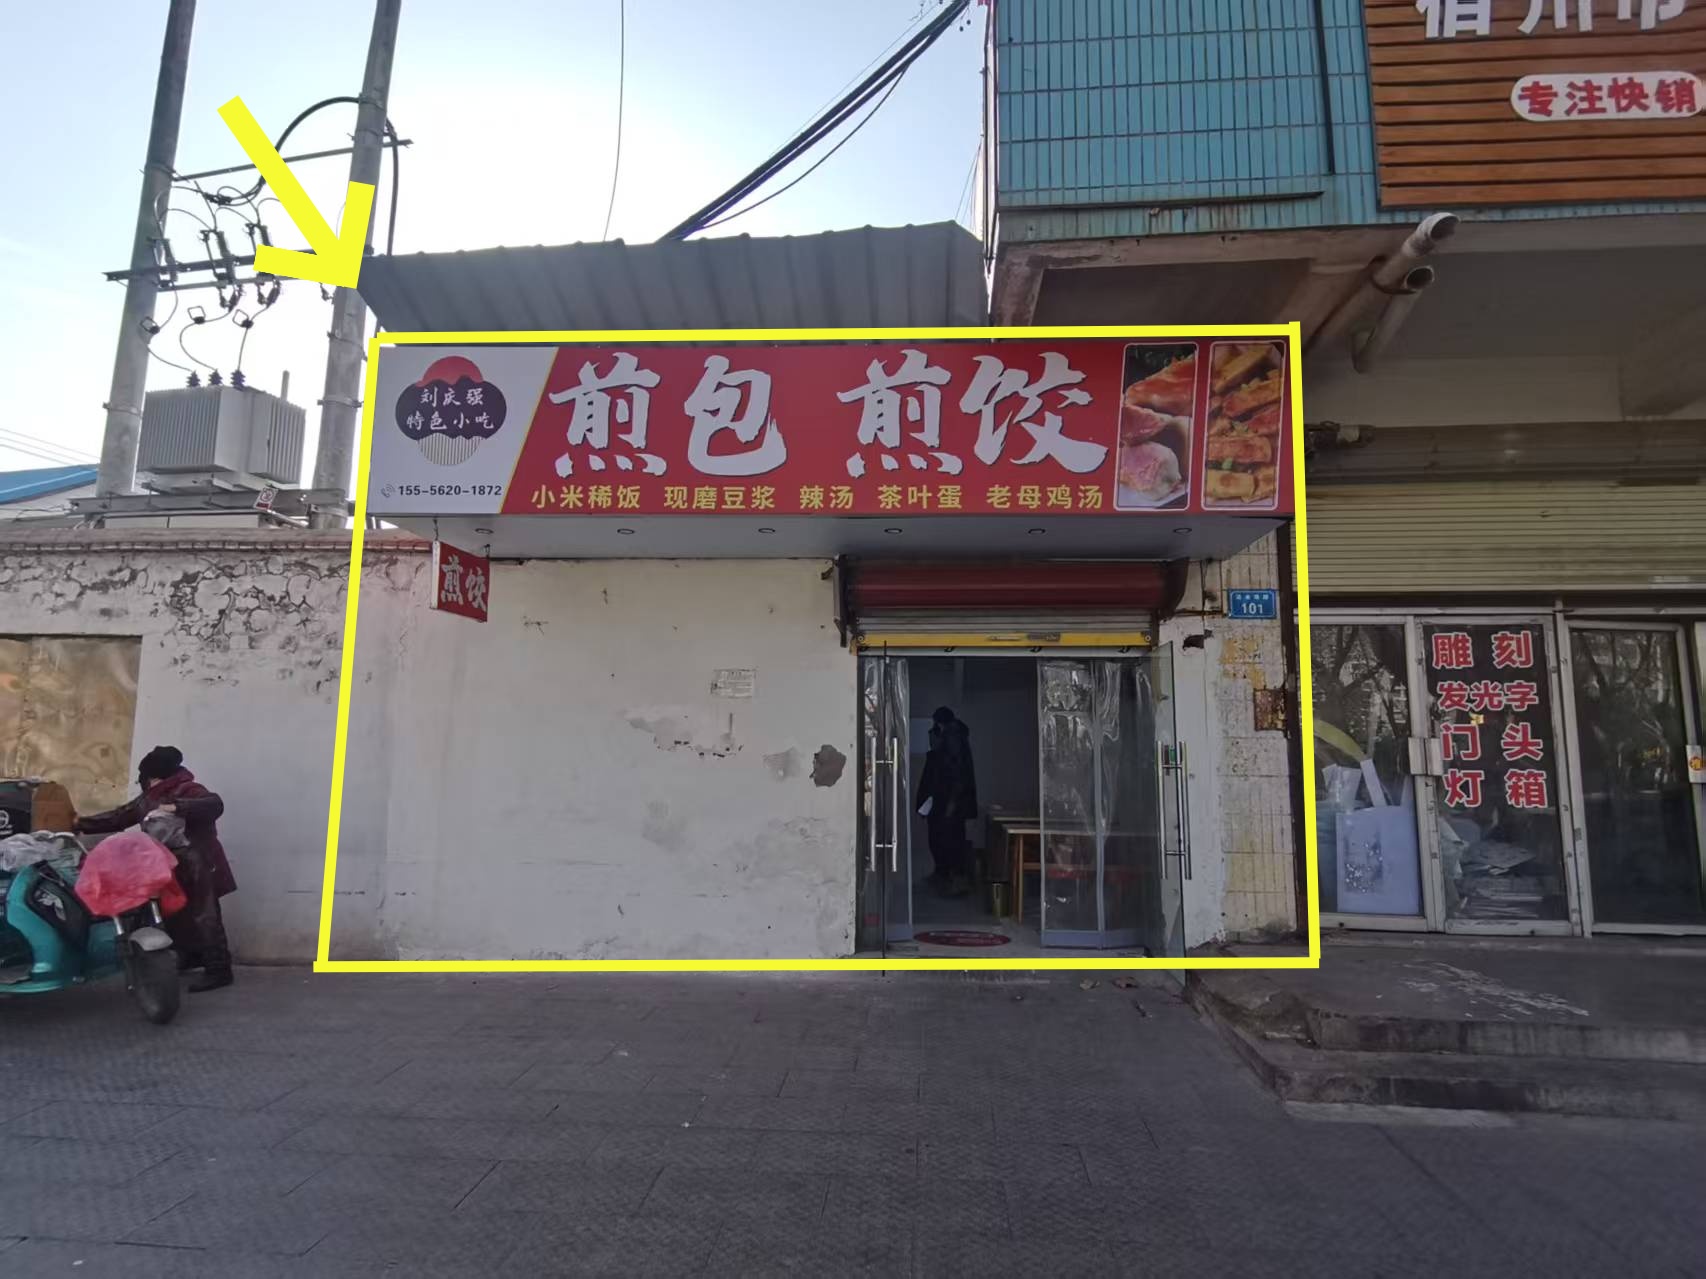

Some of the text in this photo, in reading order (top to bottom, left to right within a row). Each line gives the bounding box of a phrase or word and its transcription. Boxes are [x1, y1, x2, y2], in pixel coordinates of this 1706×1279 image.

[1518, 77, 1698, 117] 专注快销
[420, 386, 484, 407] 刘庆强
[548, 349, 1109, 478] 煎包 煎饺
[406, 410, 494, 430] 特色小吃
[398, 485, 502, 496] 155-5620-1872
[531, 484, 1104, 509] 小米稀饭 现磨豆浆 辣汤 茶叶蛋 老母鸡汤
[440, 553, 488, 612] 煎饺
[1241, 602, 1264, 615] 101
[1431, 630, 1535, 669] 雕刻
[1436, 680, 1539, 712] 发光字
[1441, 722, 1544, 761] 门头
[1443, 768, 1548, 808] 灯箱
